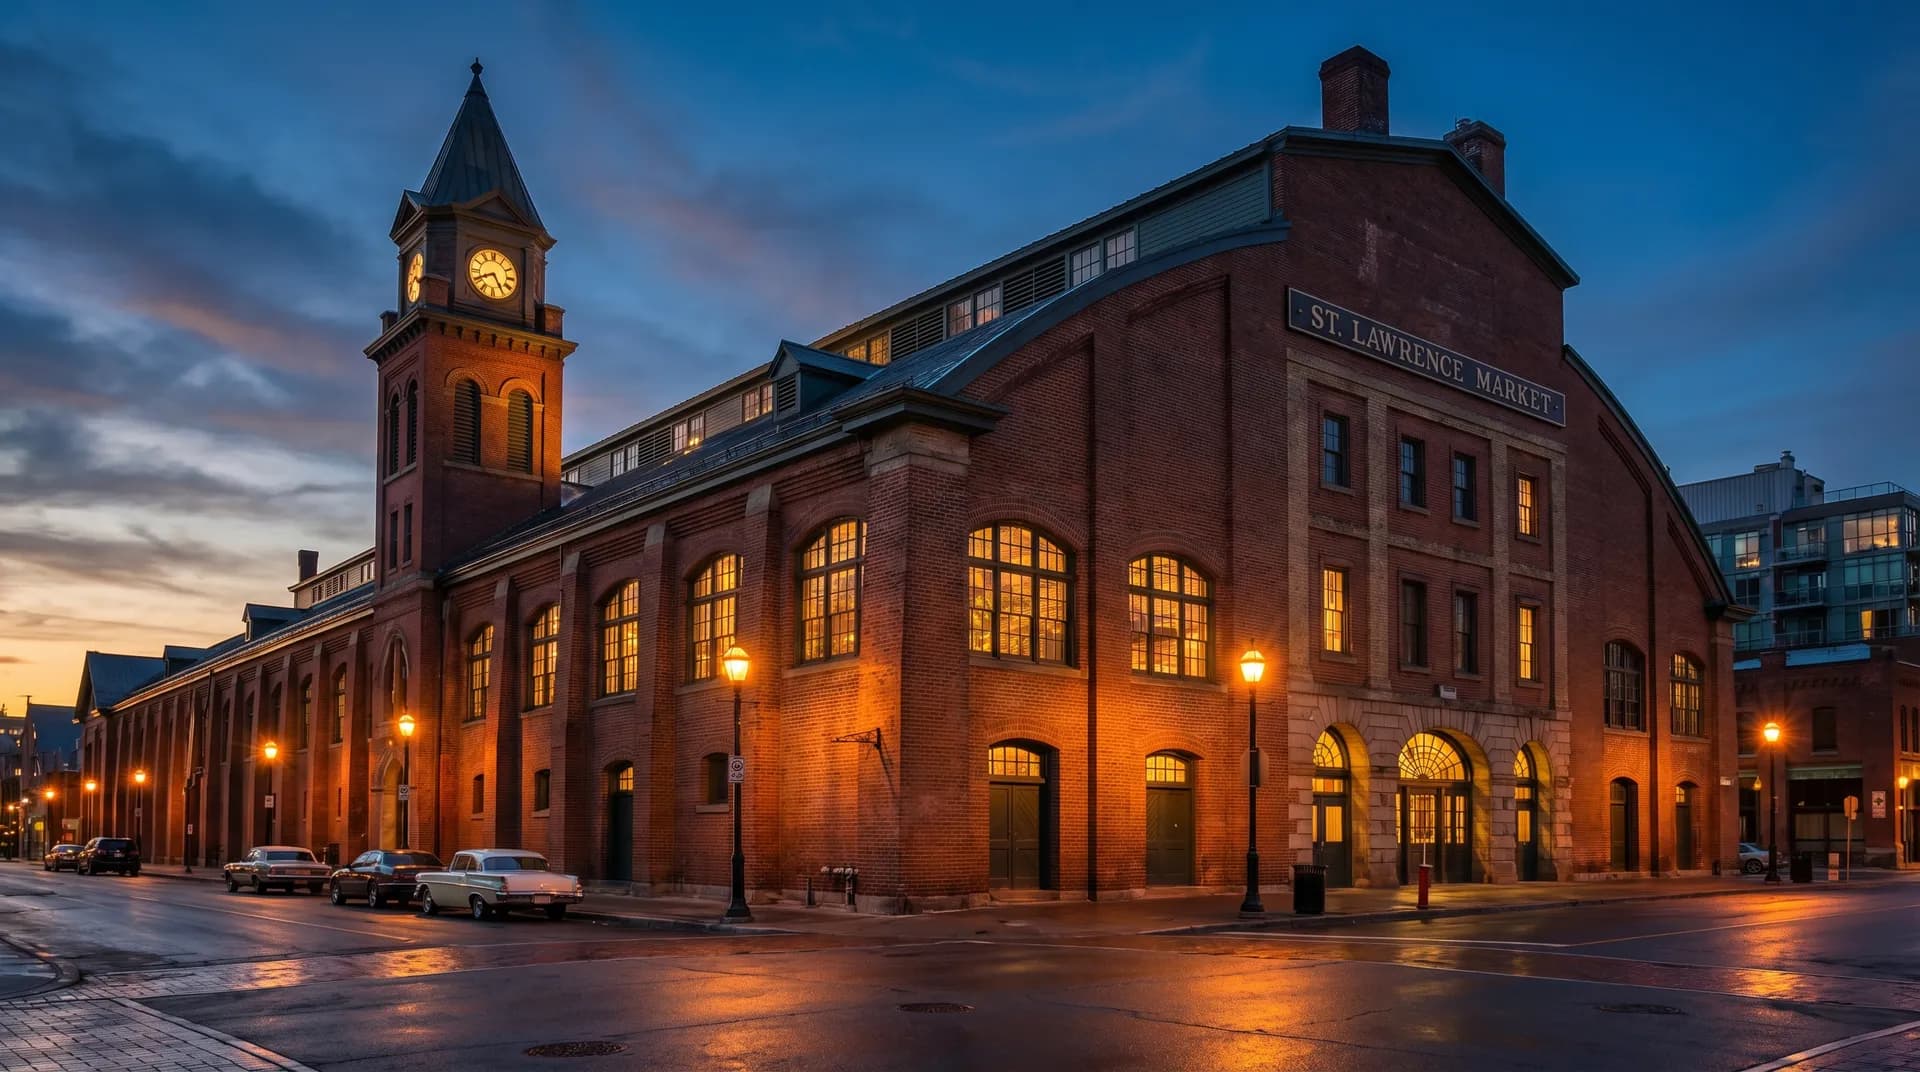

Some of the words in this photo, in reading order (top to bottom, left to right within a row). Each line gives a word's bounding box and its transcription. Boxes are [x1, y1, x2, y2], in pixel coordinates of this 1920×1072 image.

[1310, 304, 1342, 337] ST.
[1352, 319, 1464, 382] LAWRENCE
[1475, 367, 1552, 415] MARKET
